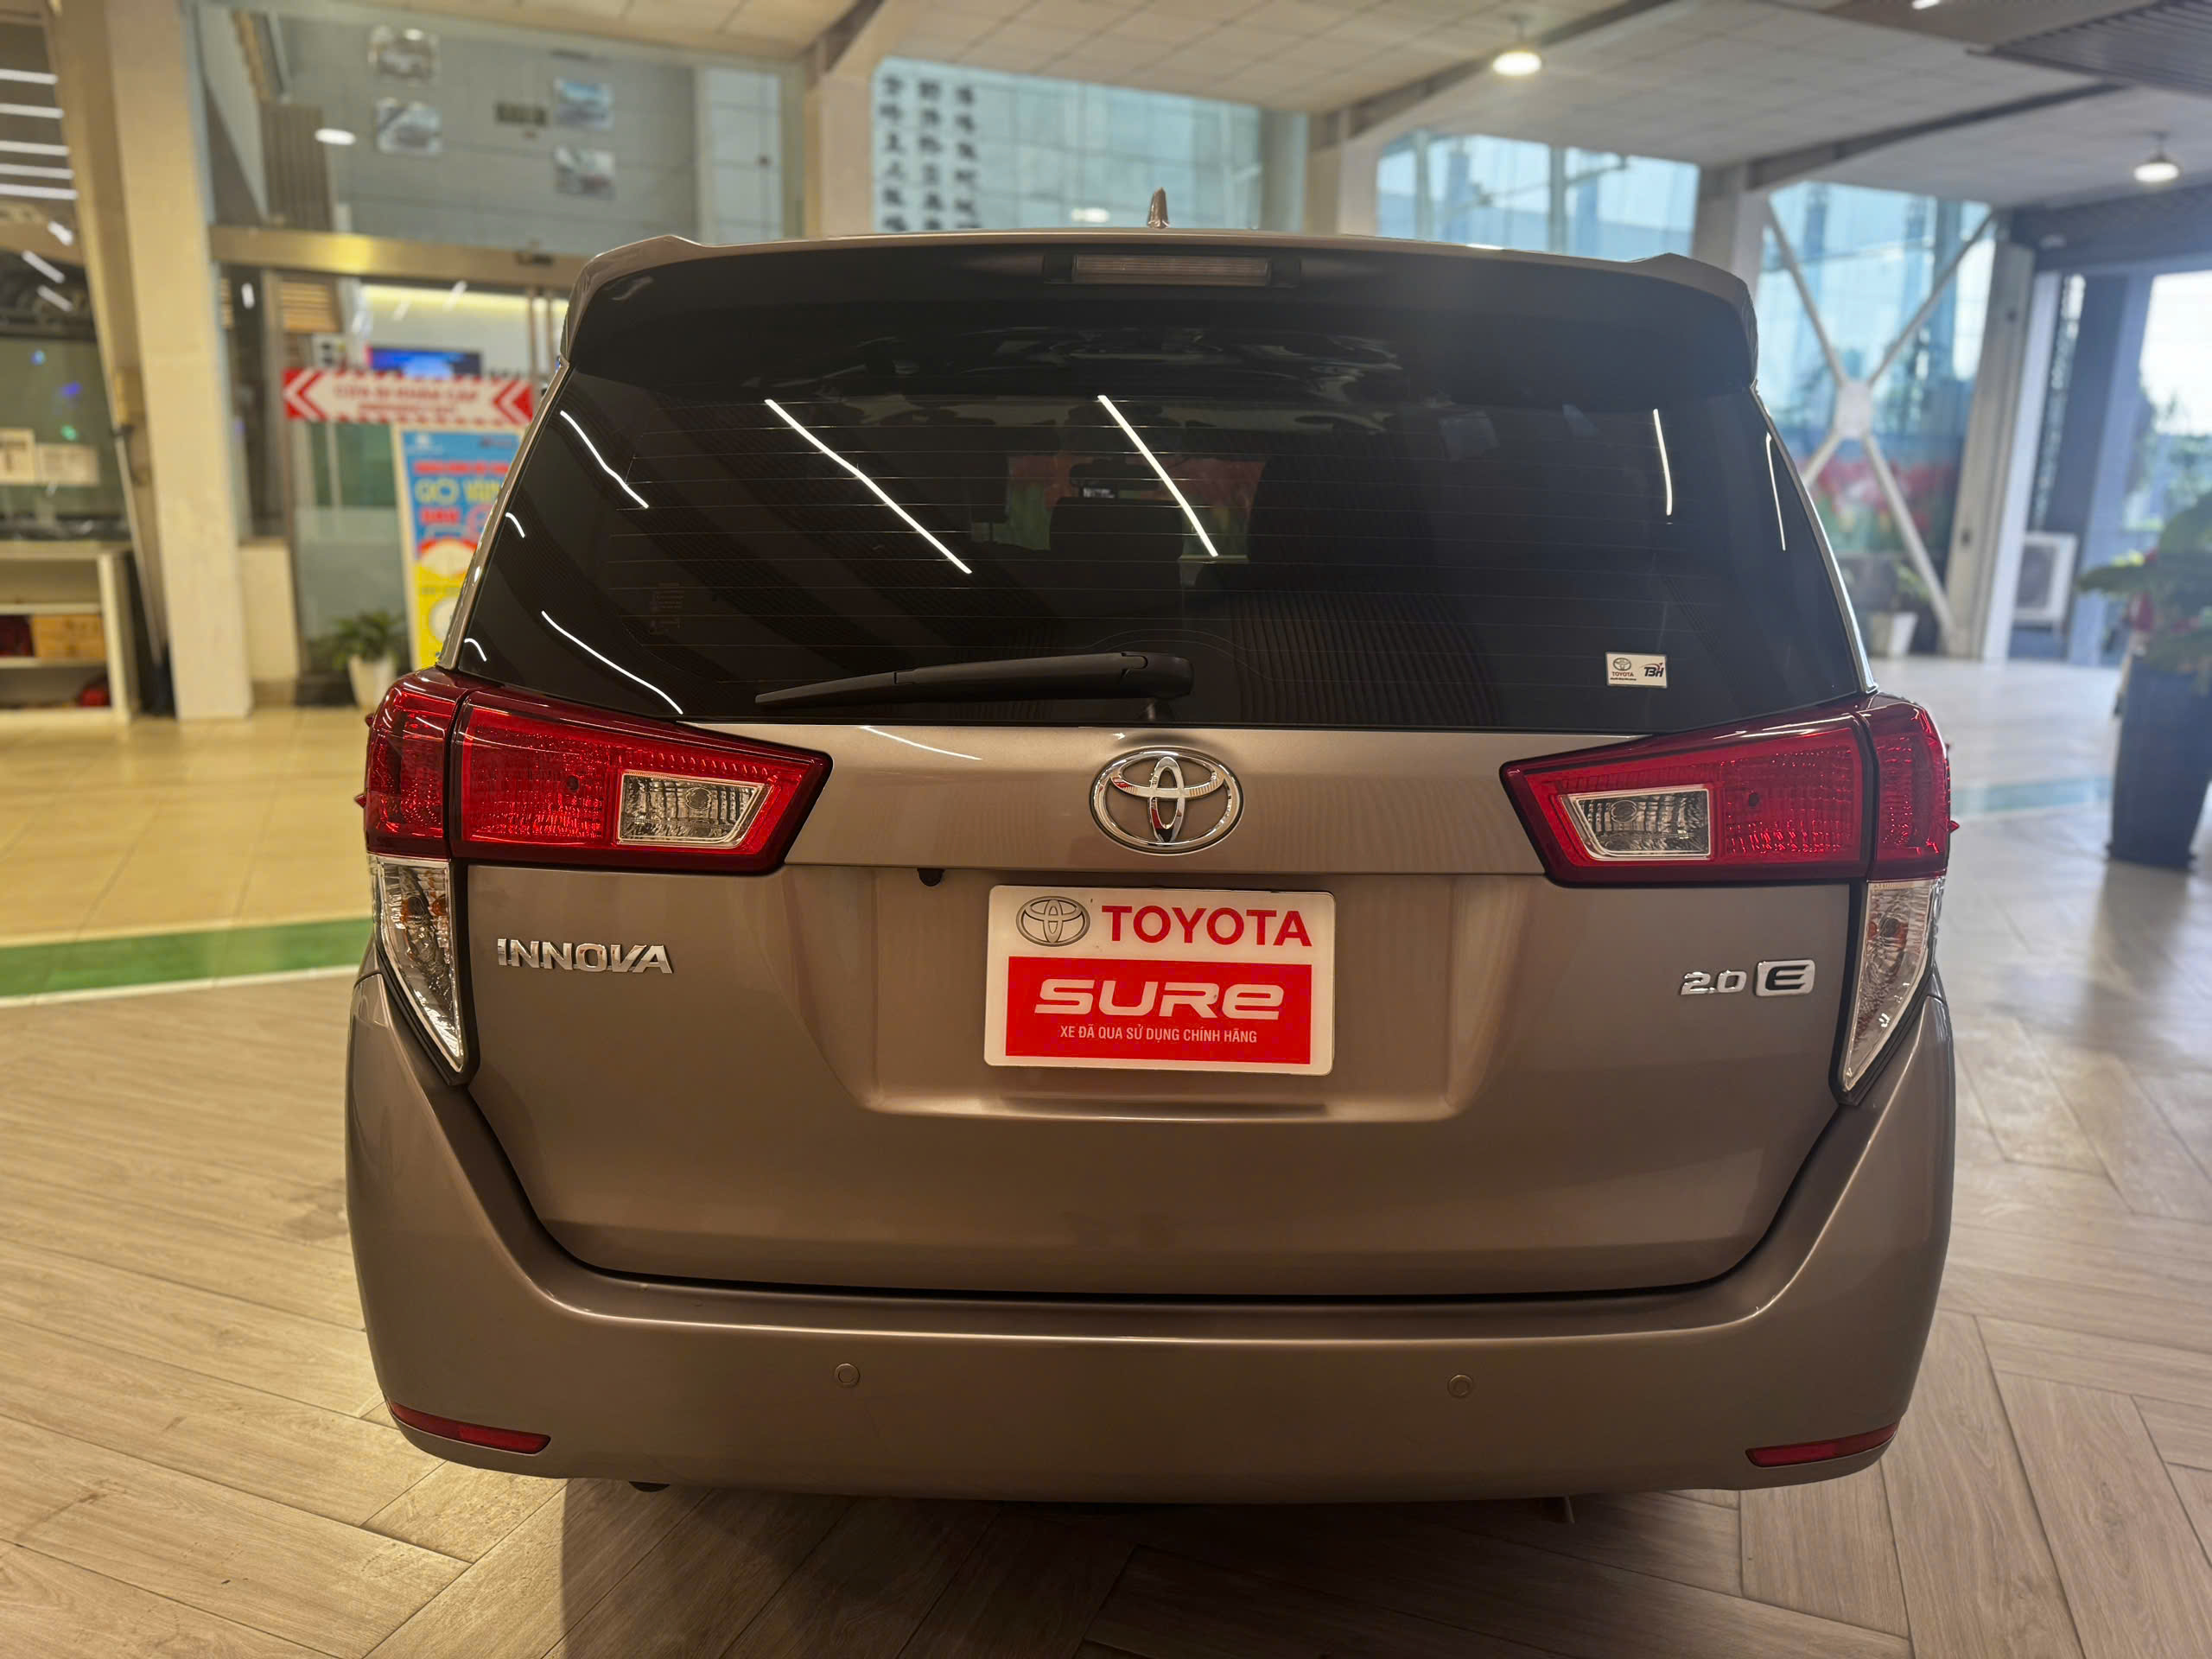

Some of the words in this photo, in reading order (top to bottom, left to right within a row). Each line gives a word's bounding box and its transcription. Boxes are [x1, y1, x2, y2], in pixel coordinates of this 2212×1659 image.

[1102, 905, 1313, 947] TOYOTA
[497, 938, 674, 974] INNOVA
[1681, 969, 1747, 995] 2.0
[1764, 962, 1811, 992] E
[1060, 1025, 1075, 1038] XE
[1078, 1023, 1095, 1039] ĐÃ
[1098, 1026, 1123, 1039] QUA
[1126, 1023, 1143, 1040] SỬ
[1146, 1027, 1180, 1043] DỤNG
[1183, 1026, 1220, 1042] CHÍNH
